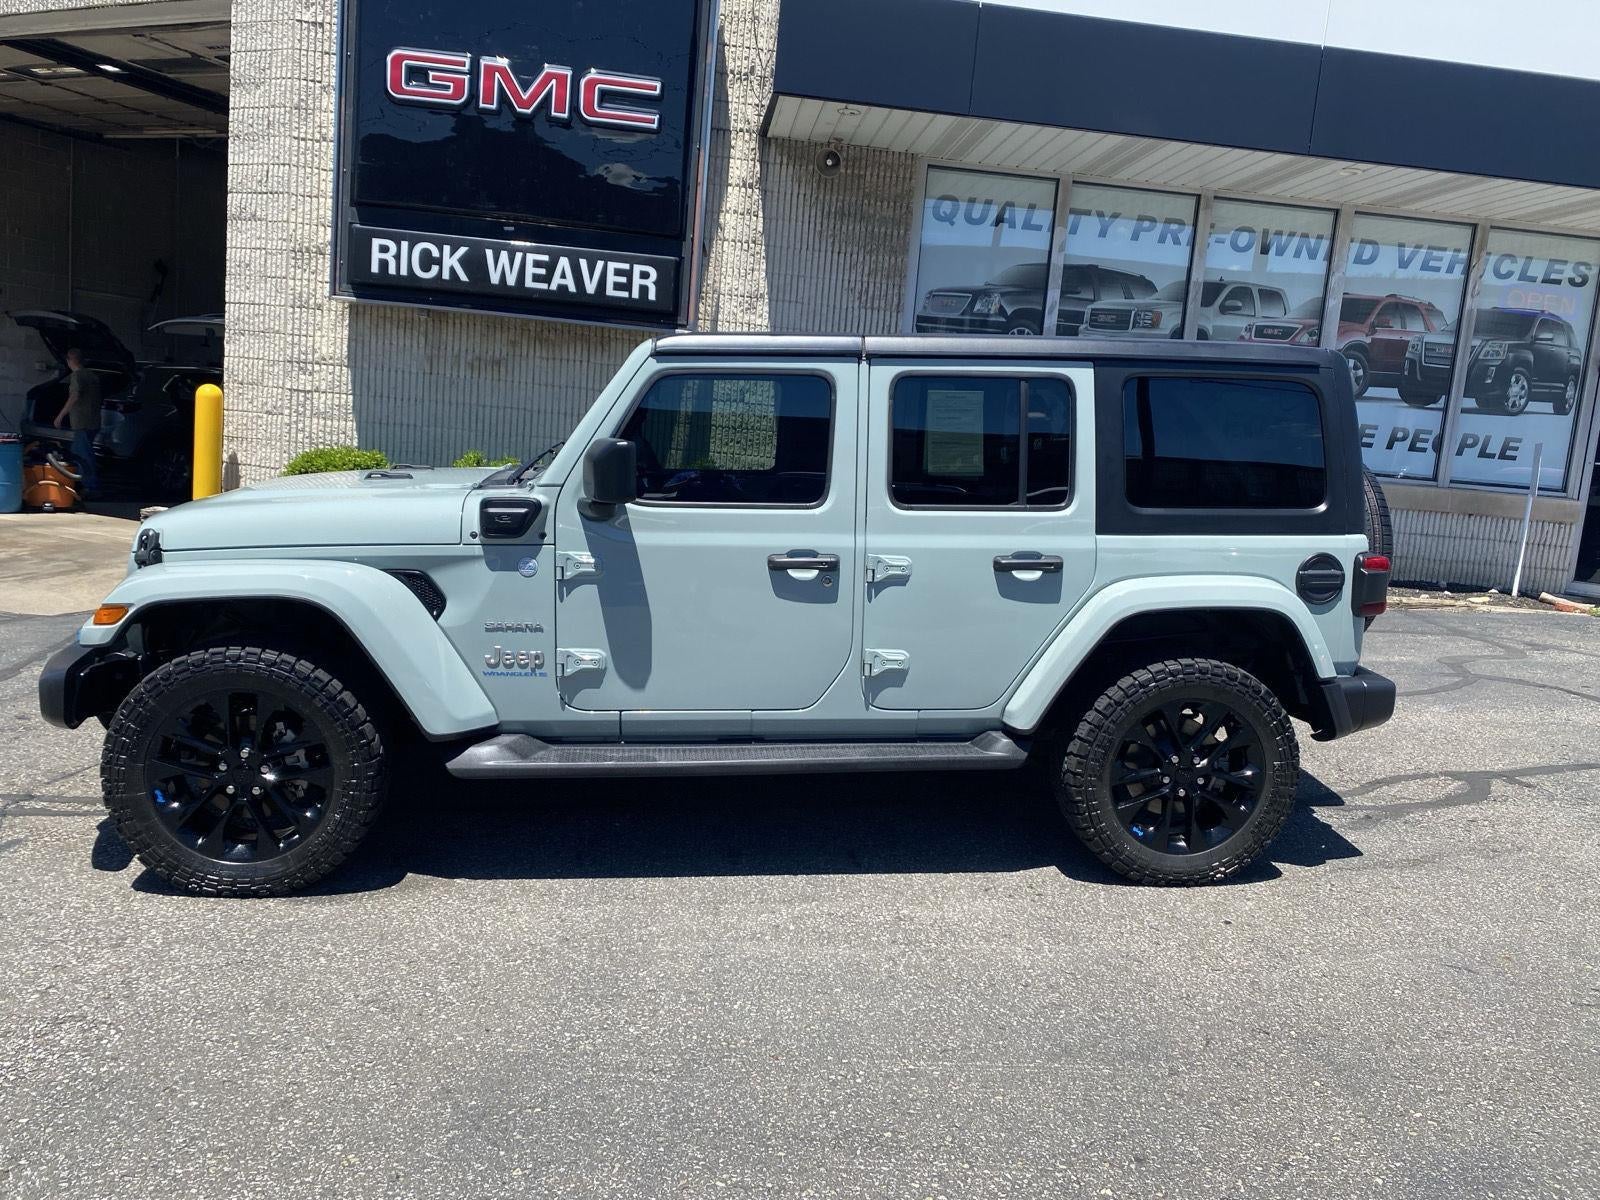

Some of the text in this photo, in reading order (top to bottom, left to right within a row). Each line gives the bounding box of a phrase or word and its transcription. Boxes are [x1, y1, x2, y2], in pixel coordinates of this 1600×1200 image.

[386, 48, 662, 130] GMC
[931, 193, 1122, 239] QUALTY
[1129, 213, 1381, 266] PR-OWND
[370, 237, 658, 301] RICK WEAVER
[1507, 288, 1577, 316] OPEN
[484, 621, 544, 634] SAHARA
[484, 645, 545, 673] Jeep
